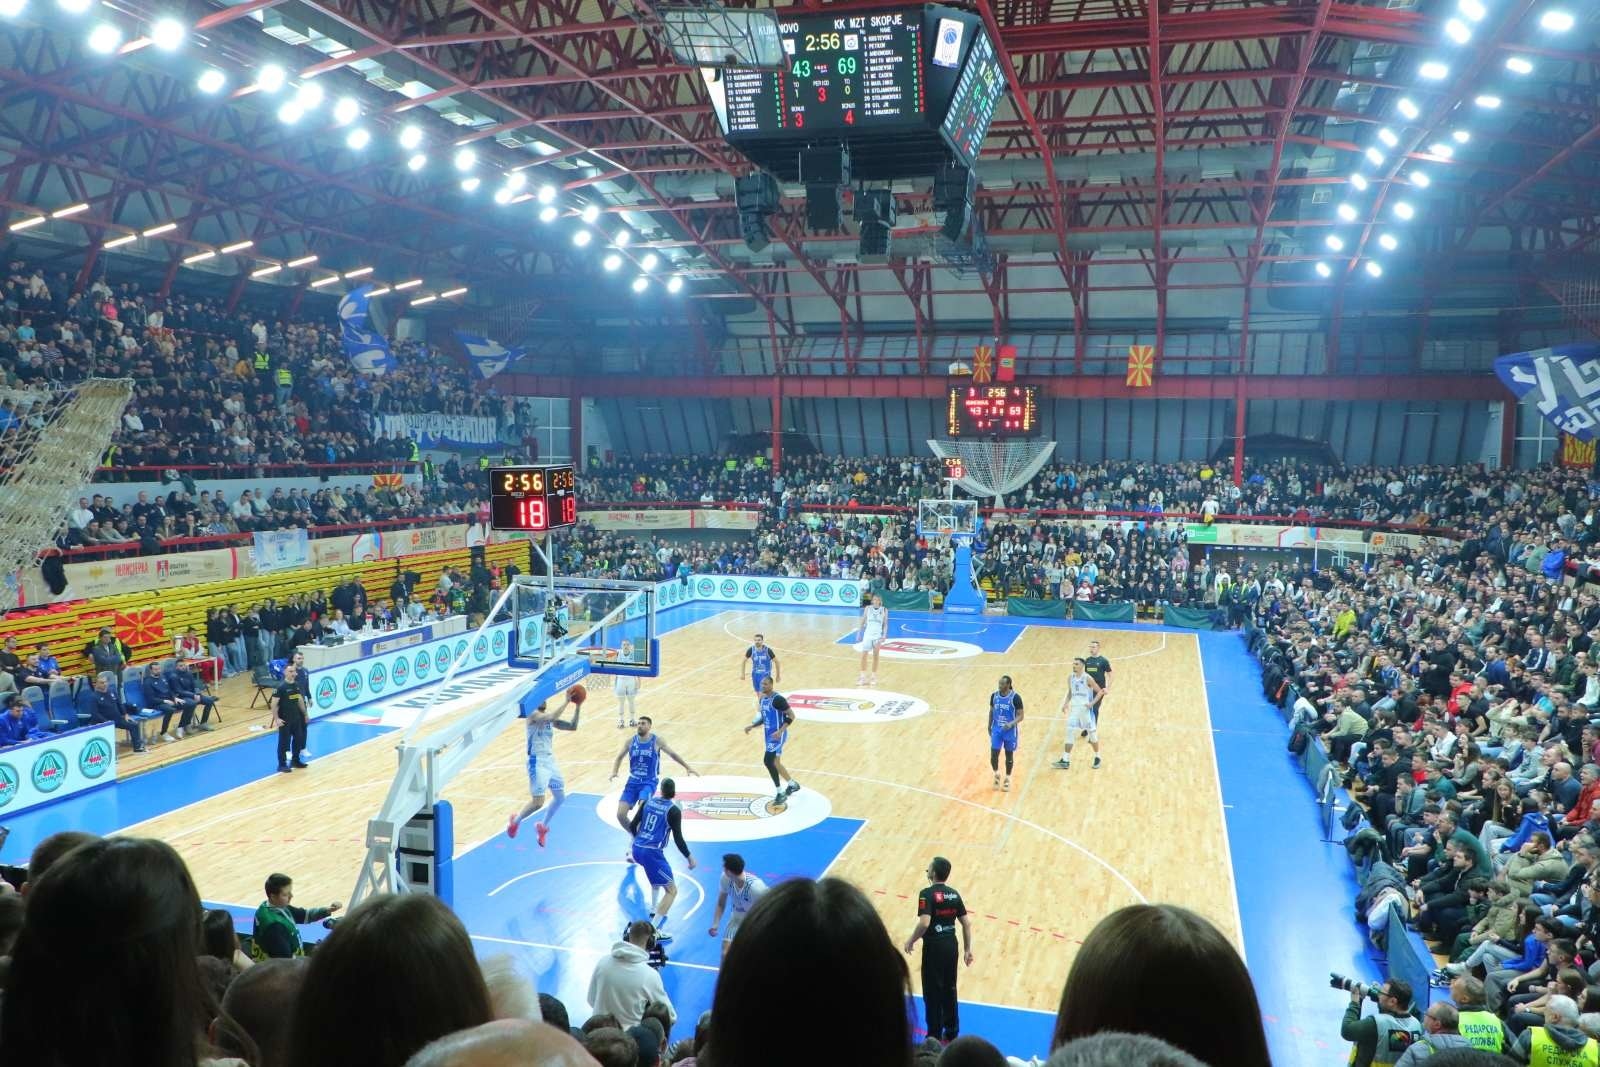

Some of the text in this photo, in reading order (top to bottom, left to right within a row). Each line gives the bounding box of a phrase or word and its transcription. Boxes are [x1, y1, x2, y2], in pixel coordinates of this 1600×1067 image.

[834, 14, 903, 29] KK MZT SKOPJE
[805, 33, 840, 51] 2:56
[793, 60, 811, 78] 43
[838, 57, 856, 75] 69
[818, 87, 826, 102] 3
[795, 112, 804, 127] 3
[844, 110, 854, 124] 4
[1009, 407, 1021, 415] 69
[504, 471, 573, 491] 2:56 2:56
[520, 497, 575, 527] 18 18
[644, 812, 658, 832] 19
[1464, 1024, 1498, 1034] РЕДАРСКА
